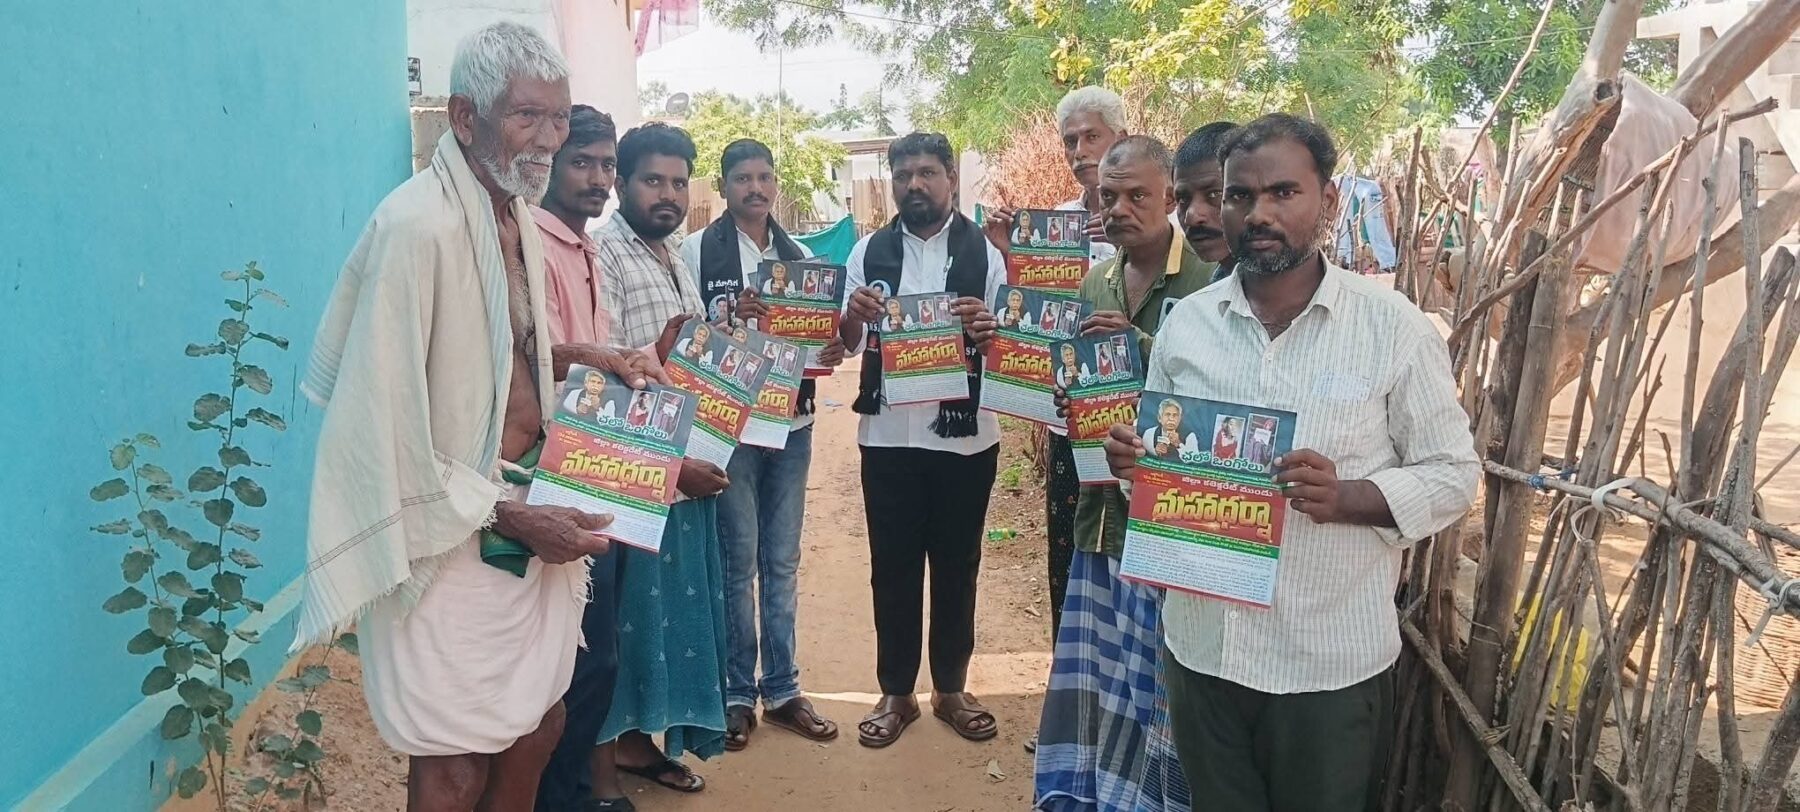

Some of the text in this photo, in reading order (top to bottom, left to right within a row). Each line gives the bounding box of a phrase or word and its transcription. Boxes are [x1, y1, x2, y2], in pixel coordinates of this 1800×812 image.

[769, 313, 832, 338] మహాధర్నా
[895, 341, 961, 370] మహాధర్నా
[625, 424, 668, 439] ఒంగోలు
[559, 449, 667, 500] మహాధర్నా
[1213, 457, 1264, 472] ఒంగోలు
[1182, 476, 1200, 486] జిల్లా
[1204, 480, 1238, 492] కలెక్టరేట్
[1240, 486, 1273, 498] ముందు
[1152, 487, 1273, 541] మహాధర్నా
